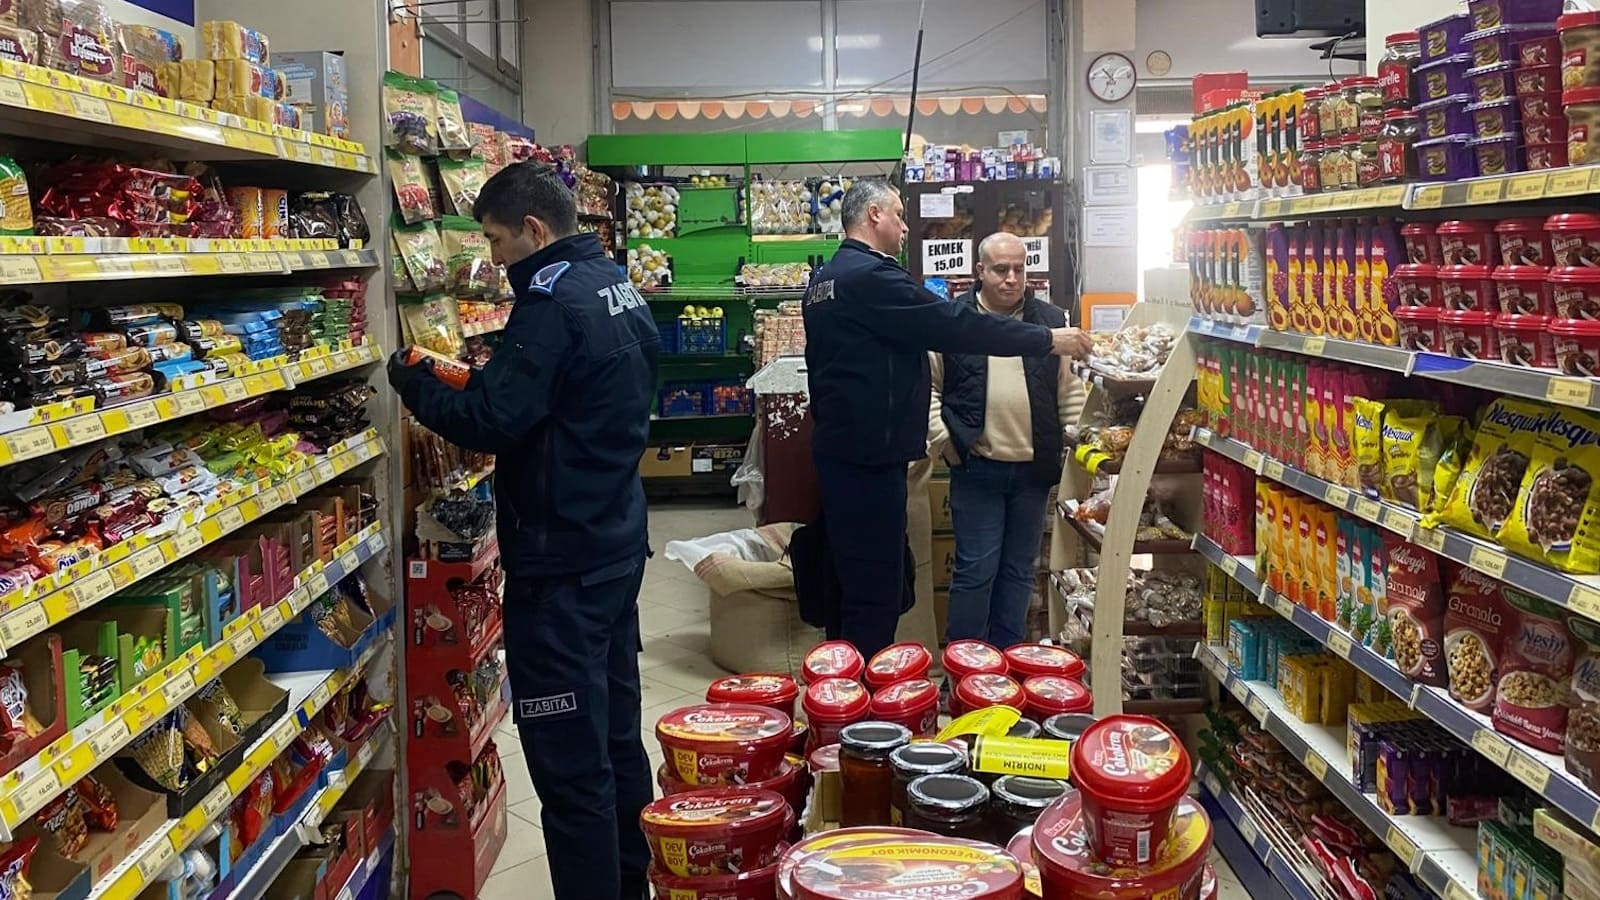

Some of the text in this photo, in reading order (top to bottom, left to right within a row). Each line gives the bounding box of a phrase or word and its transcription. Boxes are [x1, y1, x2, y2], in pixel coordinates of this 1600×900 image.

[928, 242, 964, 256] EKMEK
[934, 257, 964, 272] 15.00
[1383, 424, 1415, 442] Nesquik
[66, 494, 101, 515] KOMBO
[1387, 575, 1427, 602] Granola
[1448, 595, 1503, 626] Granola
[525, 698, 570, 714] ZABITA
[677, 752, 695, 762] DEV
[678, 765, 696, 776] BOY
[1003, 760, 1046, 773] İNDİRİM
[664, 841, 683, 852] DEV
[667, 857, 685, 867] BOY
